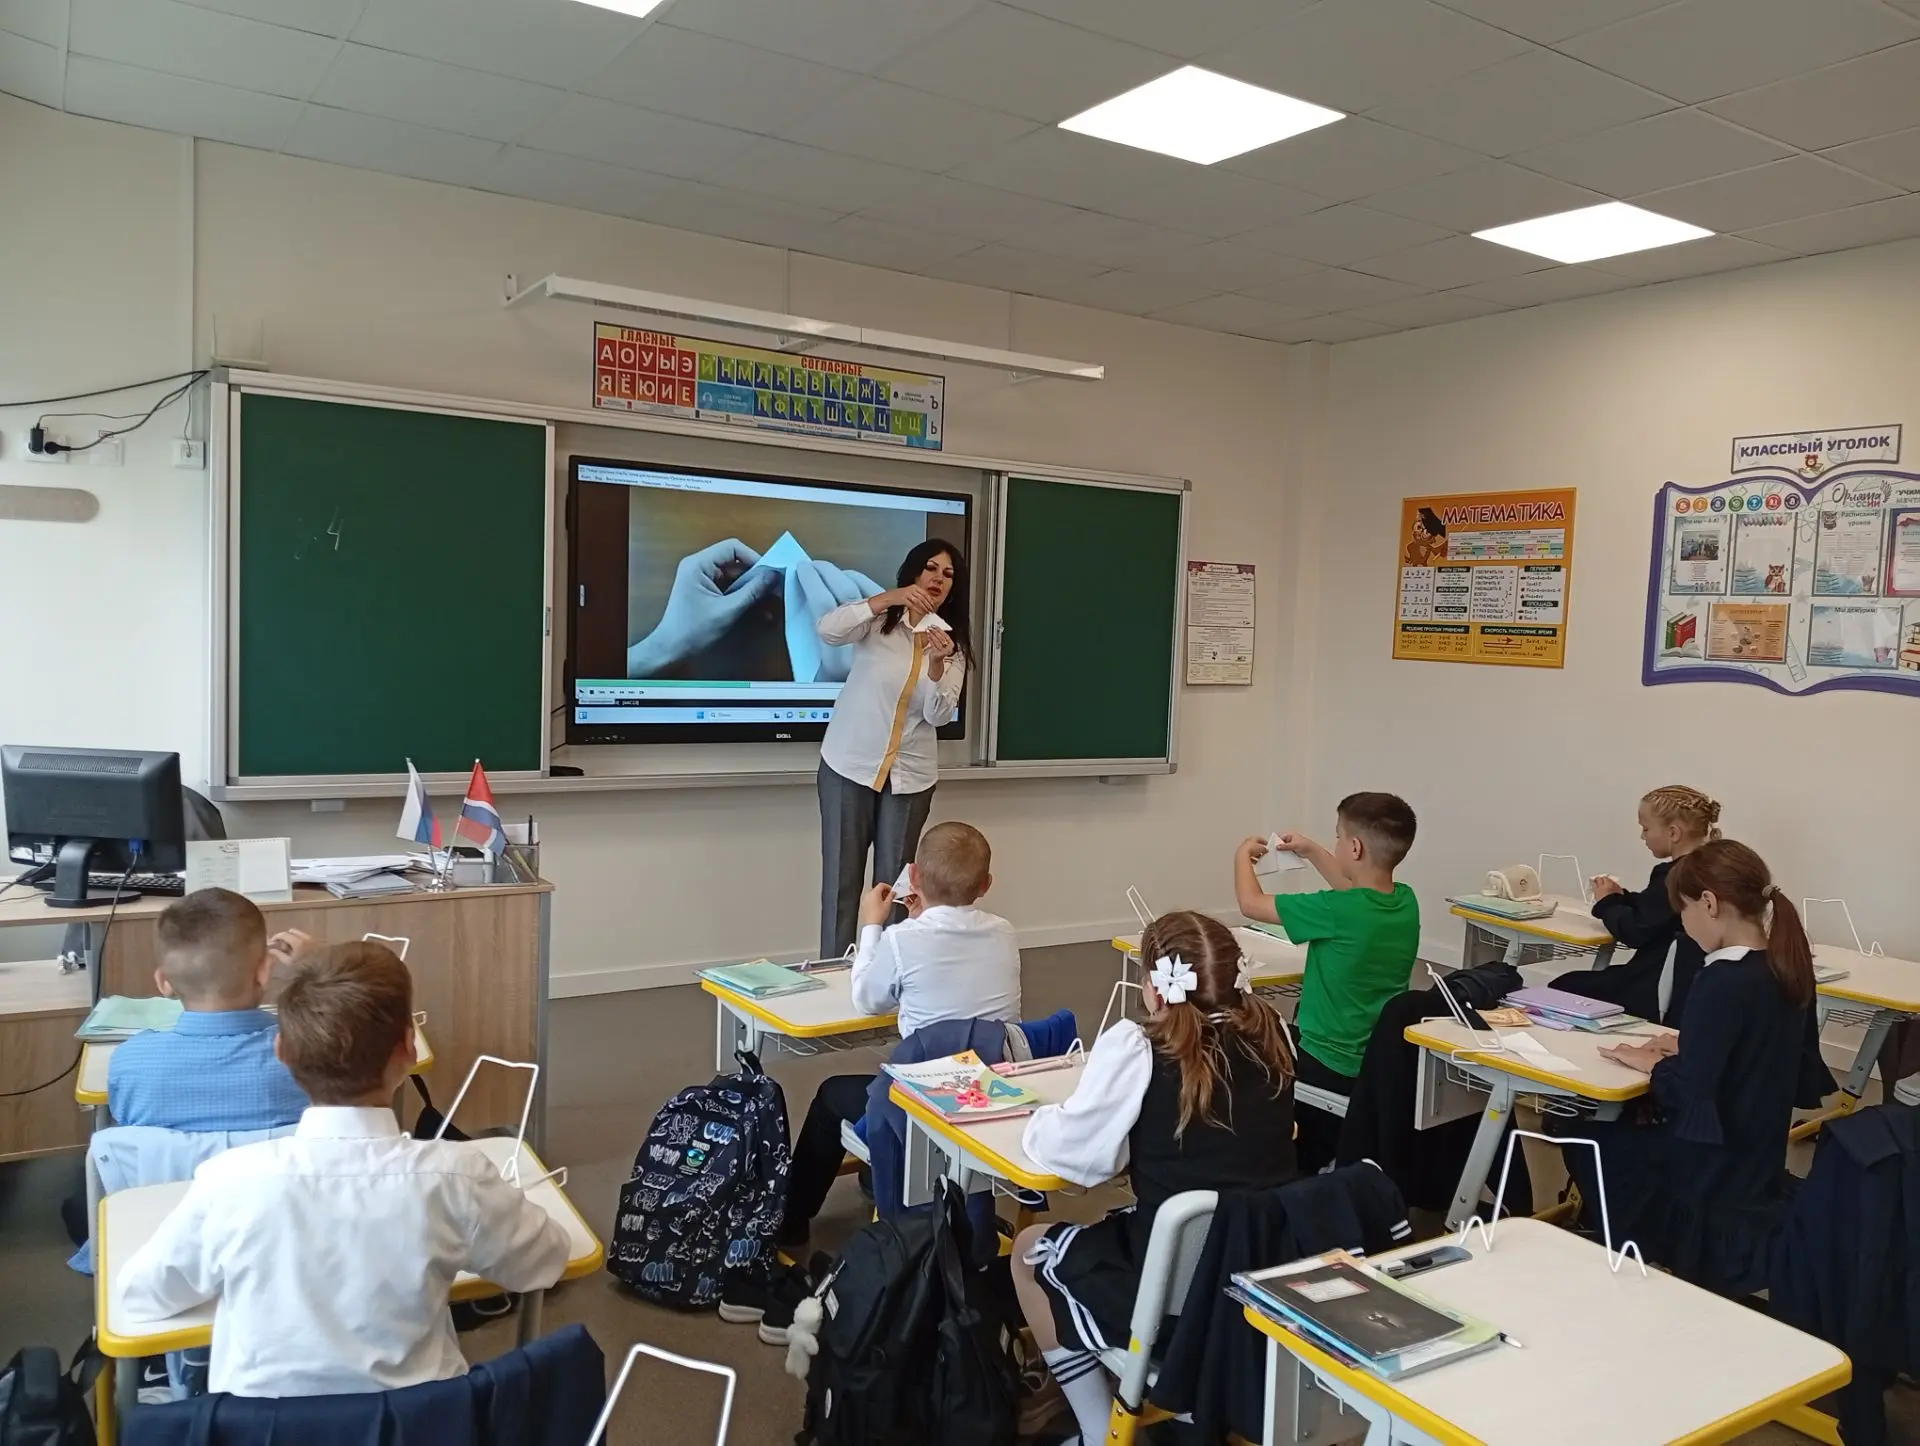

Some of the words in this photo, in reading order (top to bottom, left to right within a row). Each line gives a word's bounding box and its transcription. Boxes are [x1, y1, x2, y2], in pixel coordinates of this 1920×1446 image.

[620, 329, 677, 348] ГЛАСНЫЕ
[600, 344, 614, 362] А
[620, 347, 635, 364] О
[641, 350, 654, 367] У
[660, 354, 674, 372] Ы
[681, 357, 693, 373] Э
[801, 356, 862, 376] СОГЛАСНЫЕ
[600, 374, 612, 392] Я
[622, 373, 632, 394] Ё
[639, 378, 656, 396] Ю
[662, 382, 672, 400] И
[682, 386, 690, 402] Е
[738, 364, 752, 382] М
[794, 374, 802, 389] Б
[812, 376, 820, 391] В
[845, 380, 854, 398] Д
[861, 383, 872, 400] Ж
[774, 399, 786, 414] Ф
[794, 401, 802, 417] К
[844, 409, 852, 424] С
[862, 411, 870, 426] Х
[878, 412, 887, 430] Ц
[894, 414, 902, 430] Ч
[1740, 438, 1823, 458] КЛАССНЫЙ
[1827, 435, 1891, 453] УГОЛОК
[1832, 482, 1882, 505] Орлята
[1442, 502, 1565, 525] МАТЕМАТИКА
[327, 504, 344, 551] 4
[901, 1067, 978, 1079] Математика
[988, 1079, 1025, 1098] 4
